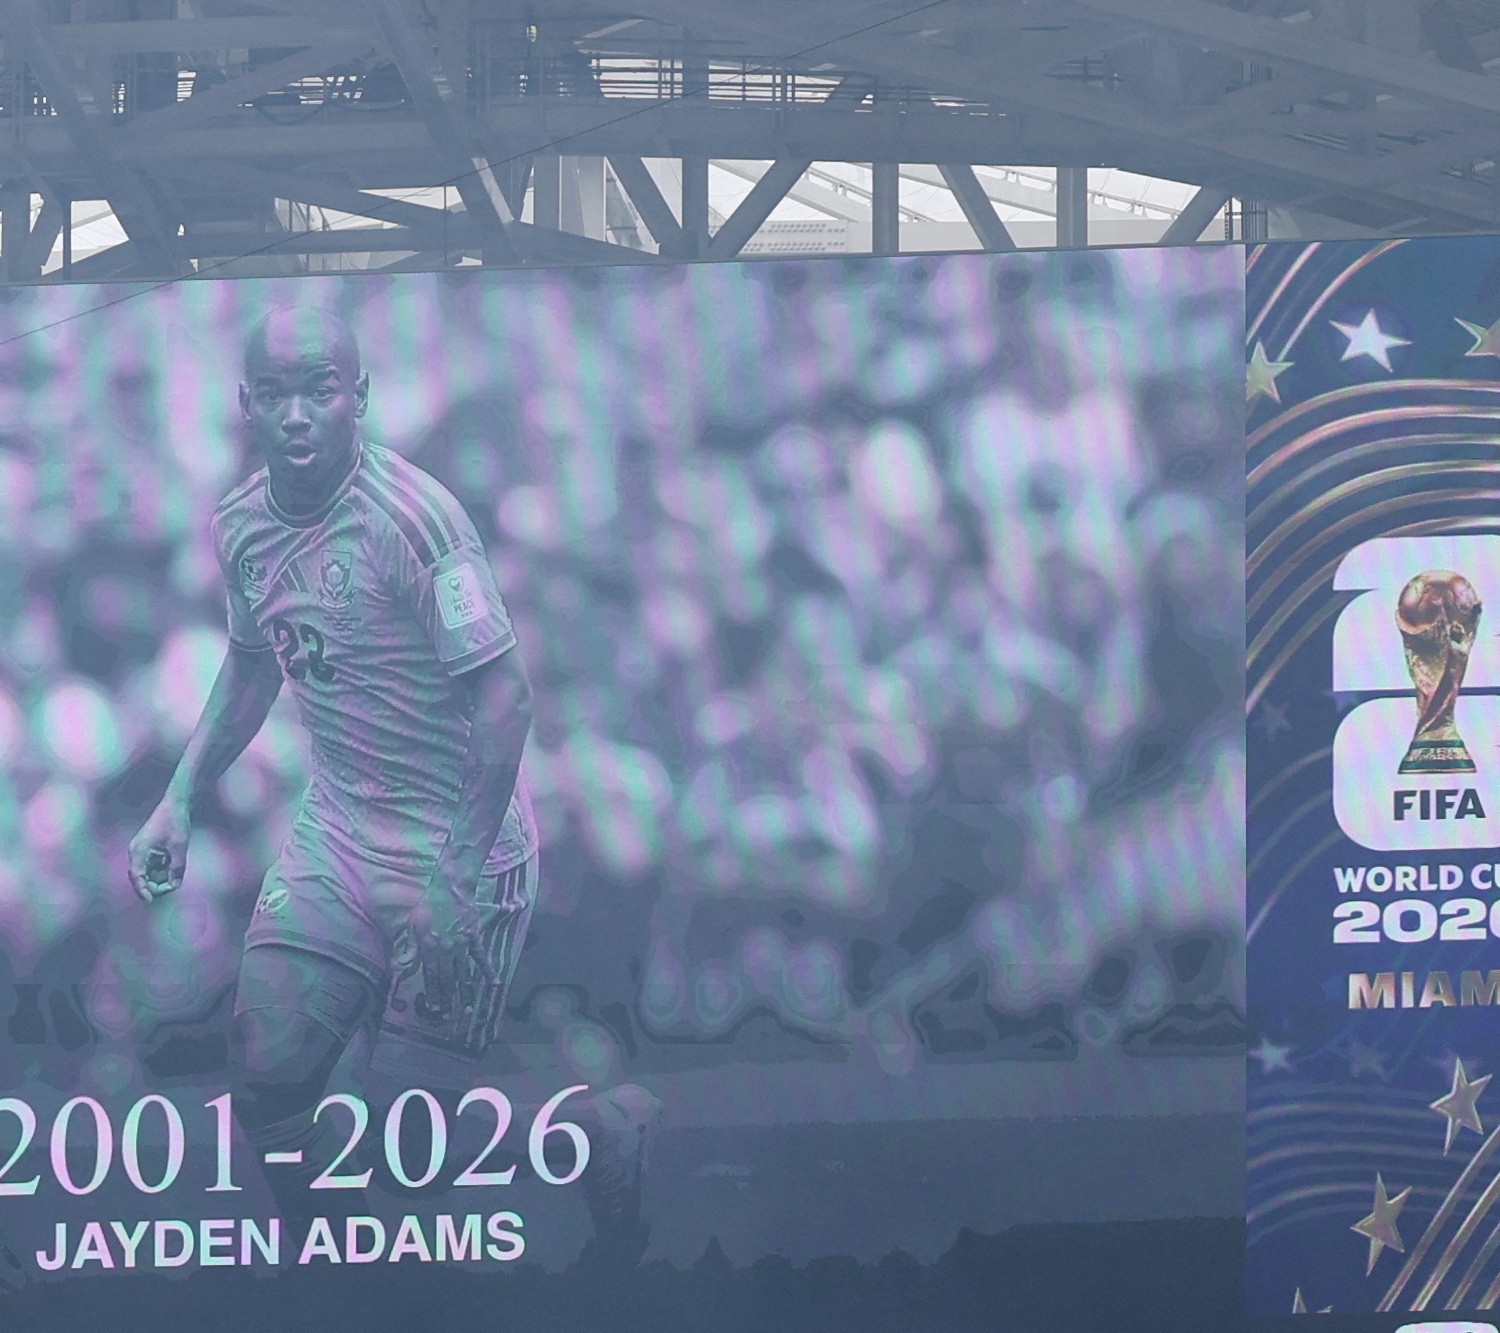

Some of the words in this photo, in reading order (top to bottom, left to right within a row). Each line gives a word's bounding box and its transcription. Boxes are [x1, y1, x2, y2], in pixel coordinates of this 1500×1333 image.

[1393, 788, 1486, 821] FIFA
[1333, 864, 1464, 893] WORLD
[36, 1218, 281, 1271] JAYDEN
[299, 1211, 526, 1265] ADAMS
